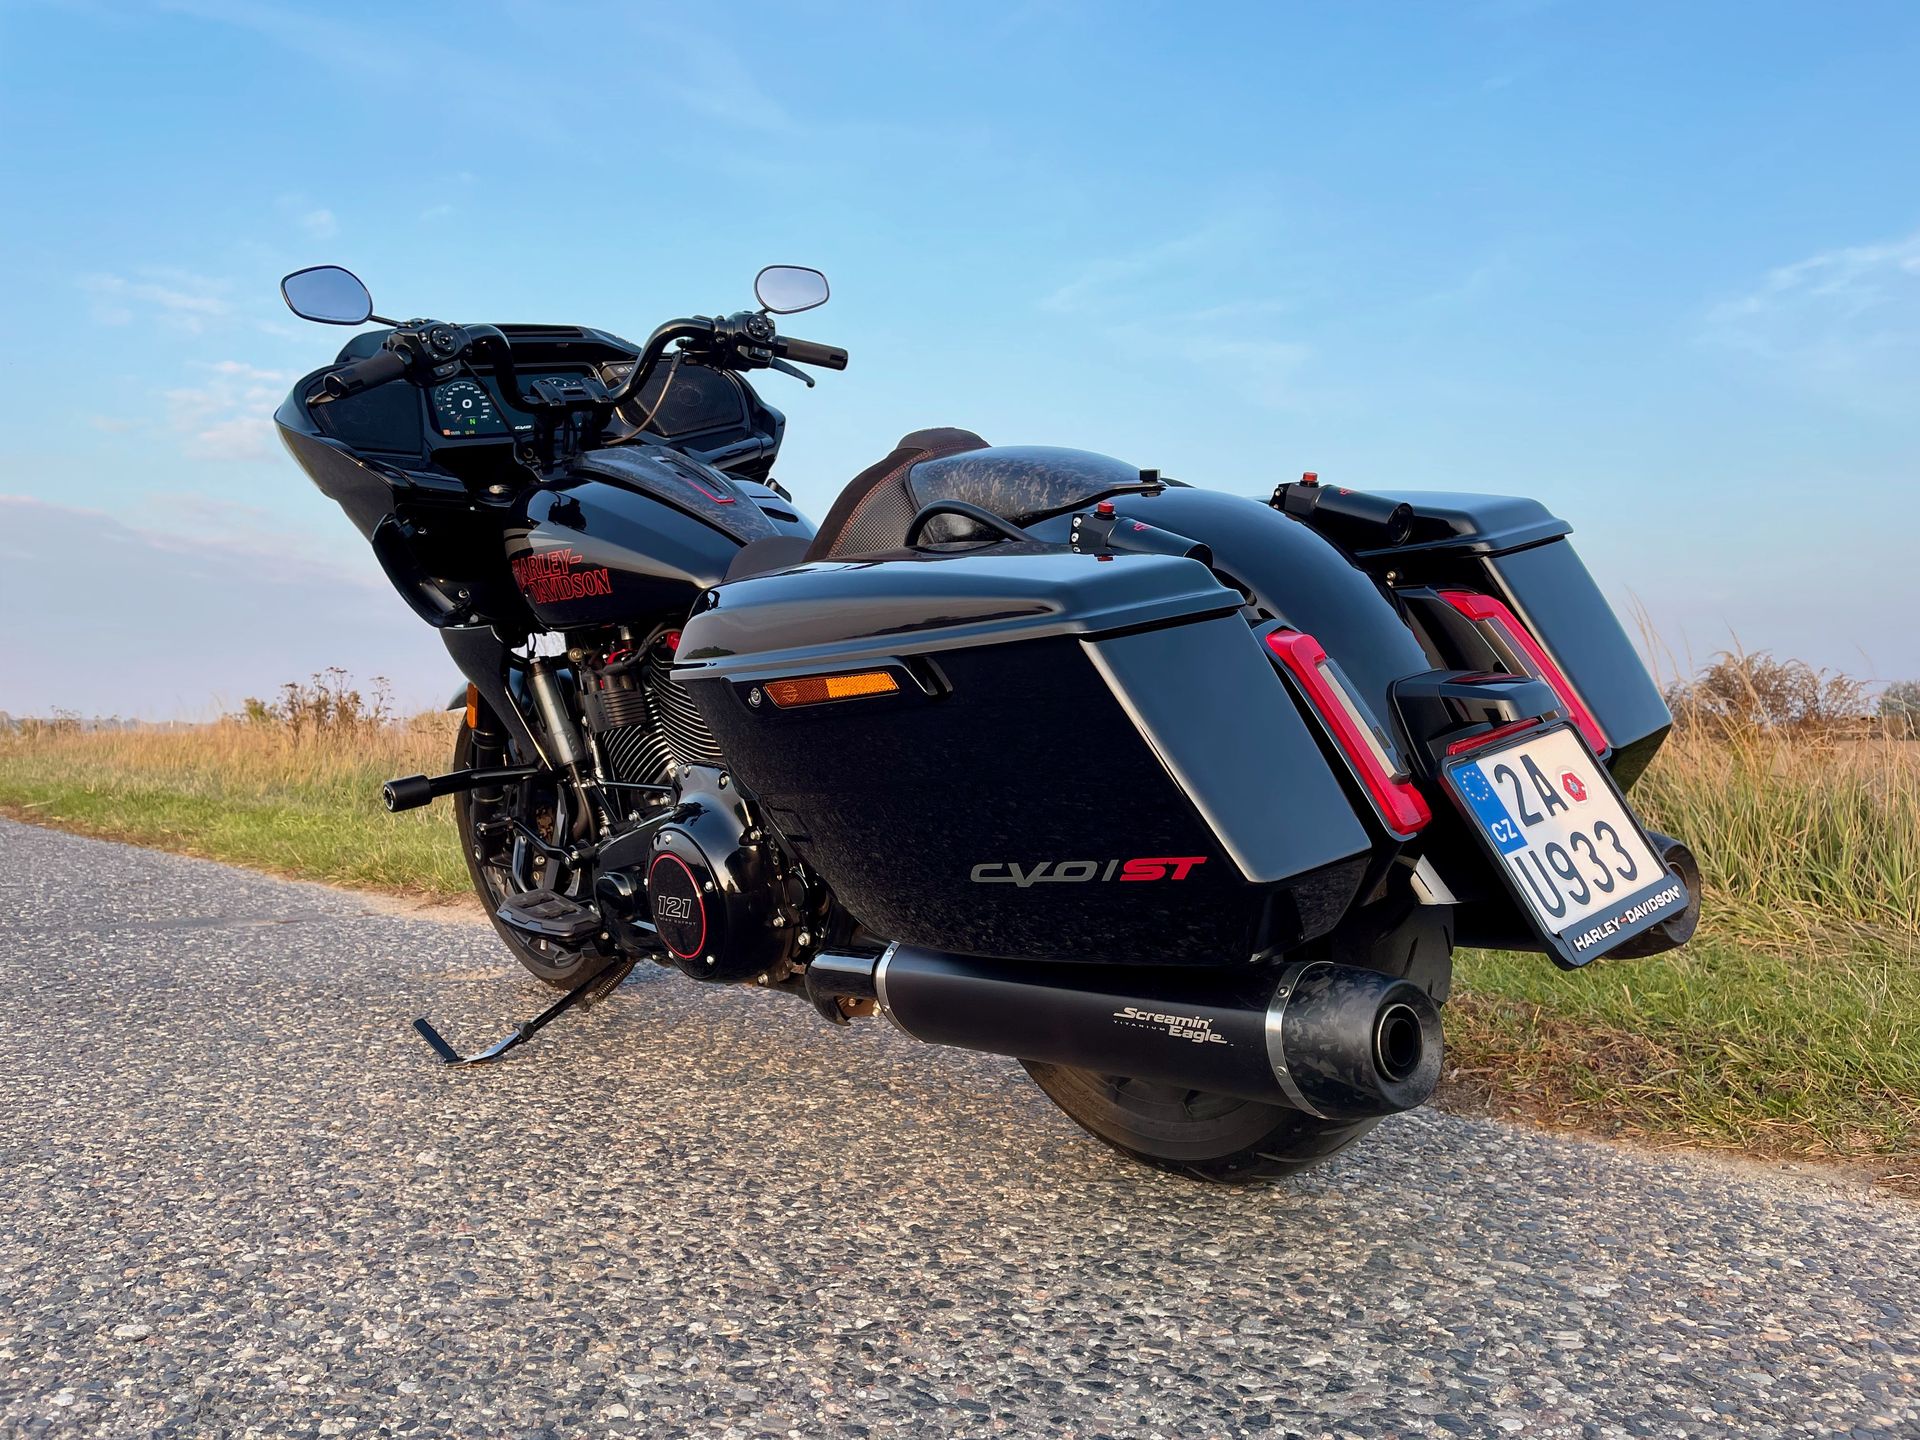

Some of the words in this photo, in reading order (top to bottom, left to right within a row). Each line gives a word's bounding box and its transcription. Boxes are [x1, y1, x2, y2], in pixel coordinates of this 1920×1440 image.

[1493, 754, 1569, 827] 2A
[1491, 818, 1518, 843] CZ
[1514, 820, 1637, 918] U933
[658, 895, 691, 919] 121
[1113, 1007, 1213, 1030] Screamin'
[1168, 1025, 1228, 1043] Eagle
